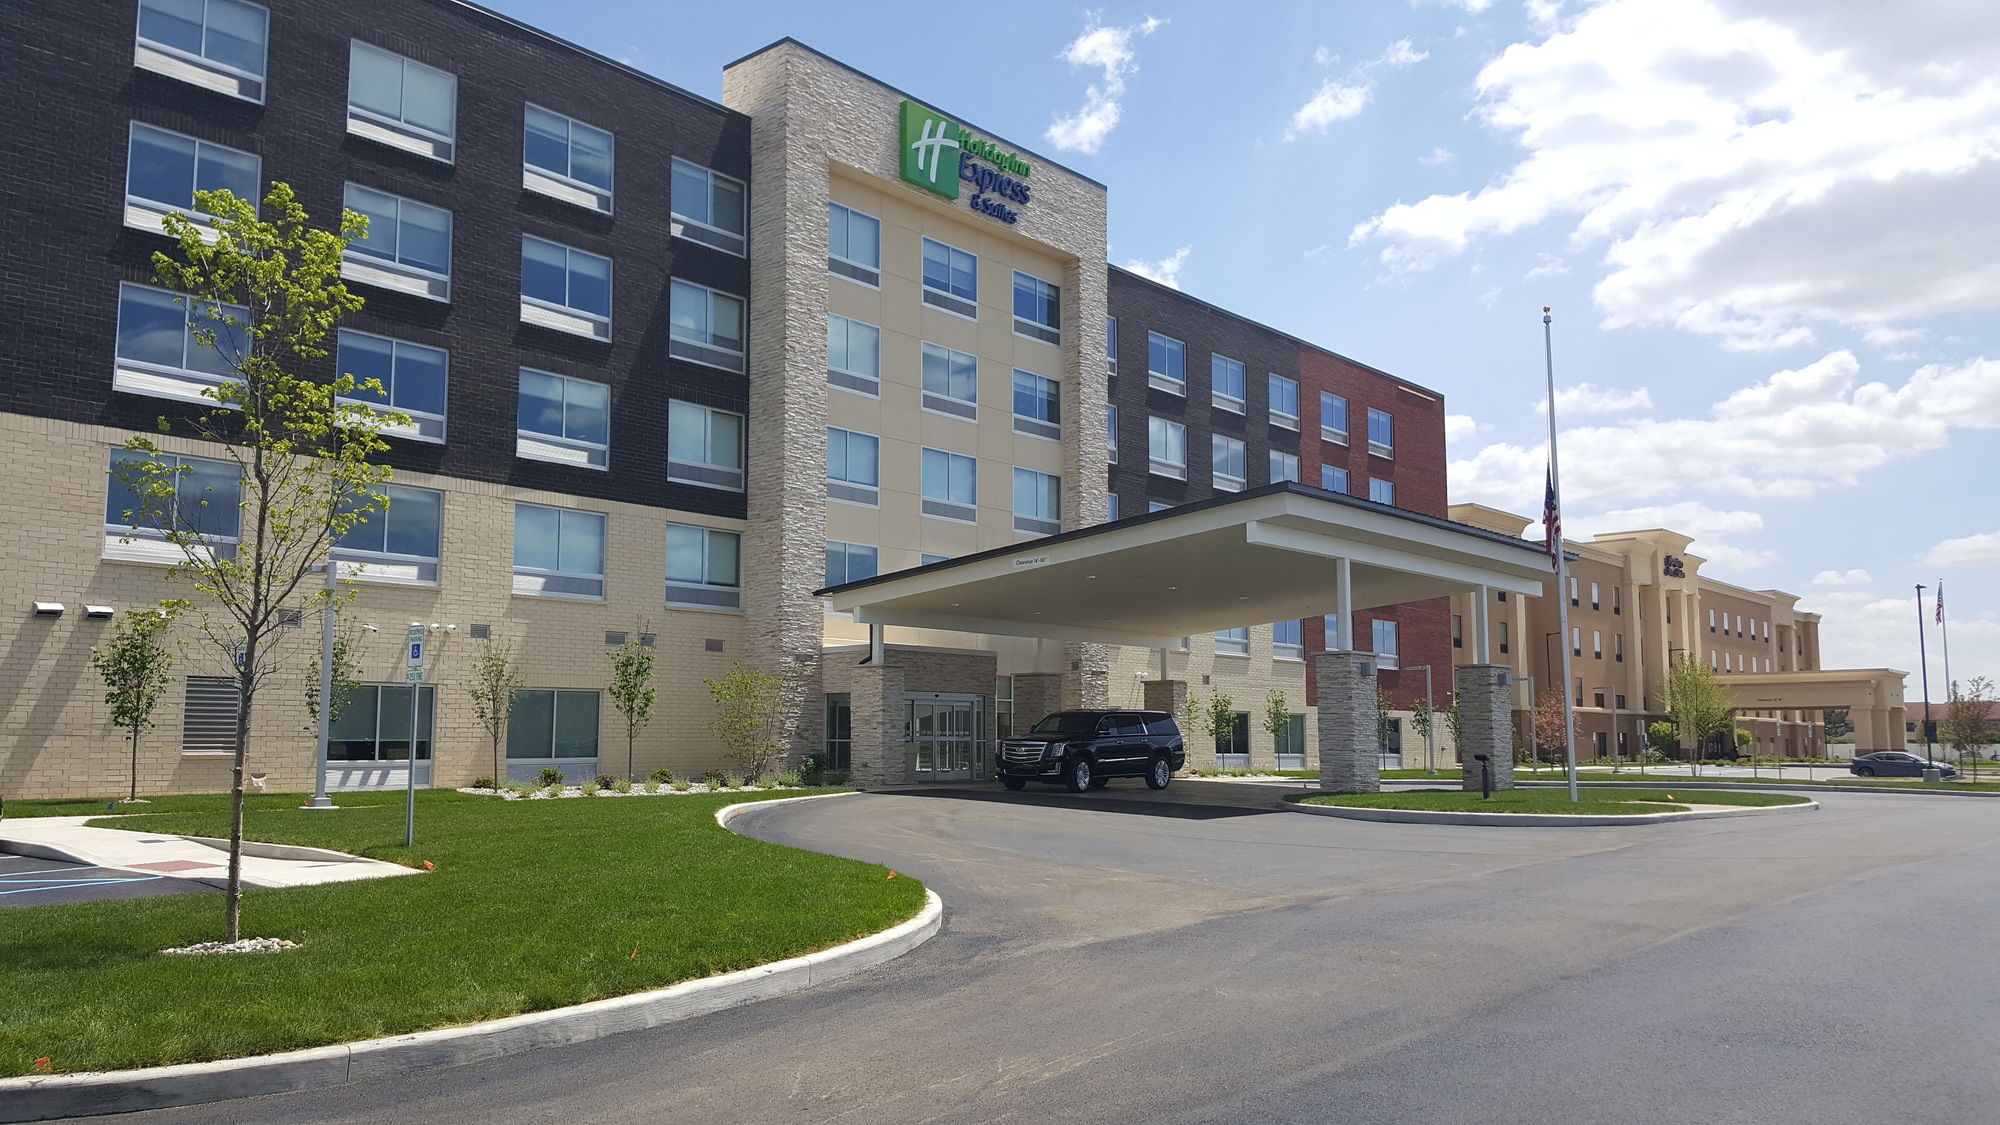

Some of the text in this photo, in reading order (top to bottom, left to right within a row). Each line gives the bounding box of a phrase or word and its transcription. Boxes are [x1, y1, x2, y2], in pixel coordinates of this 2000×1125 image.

[958, 129, 1031, 177] Holiday Inn
[959, 152, 1031, 205] Express
[981, 197, 1018, 224] Suites
